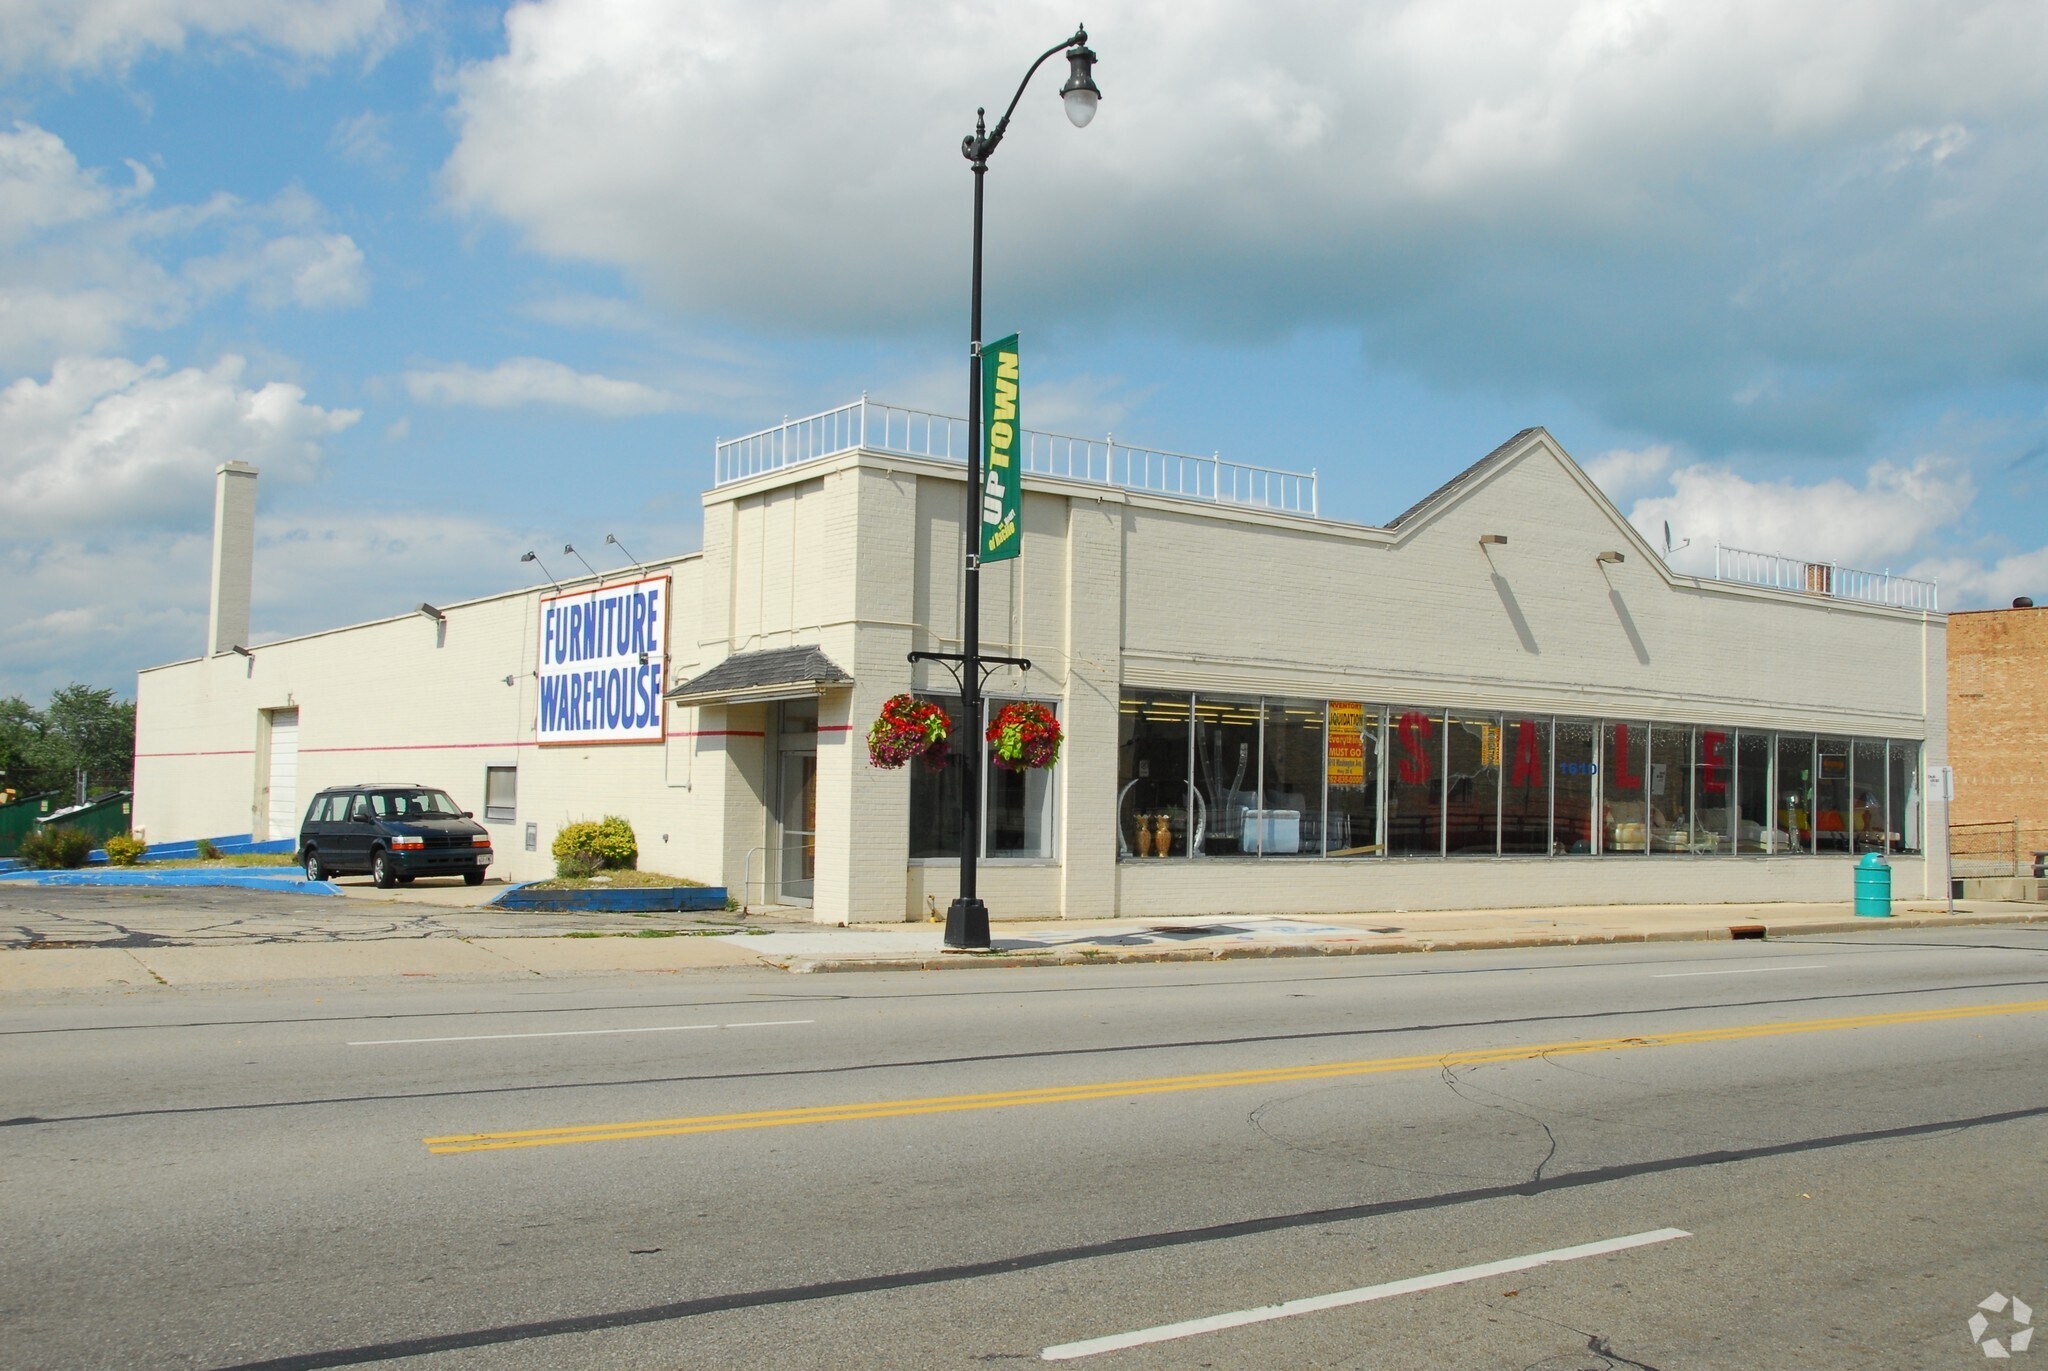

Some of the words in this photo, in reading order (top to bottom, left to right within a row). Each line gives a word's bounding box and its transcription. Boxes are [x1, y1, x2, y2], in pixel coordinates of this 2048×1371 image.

[983, 351, 1018, 525] UPTOWN
[545, 590, 658, 664] FURNITURE
[541, 664, 661, 732] WAREHOUSE
[1329, 747, 1349, 757] MUST
[1349, 748, 1362, 757] GO
[1560, 761, 1597, 776] 1610
